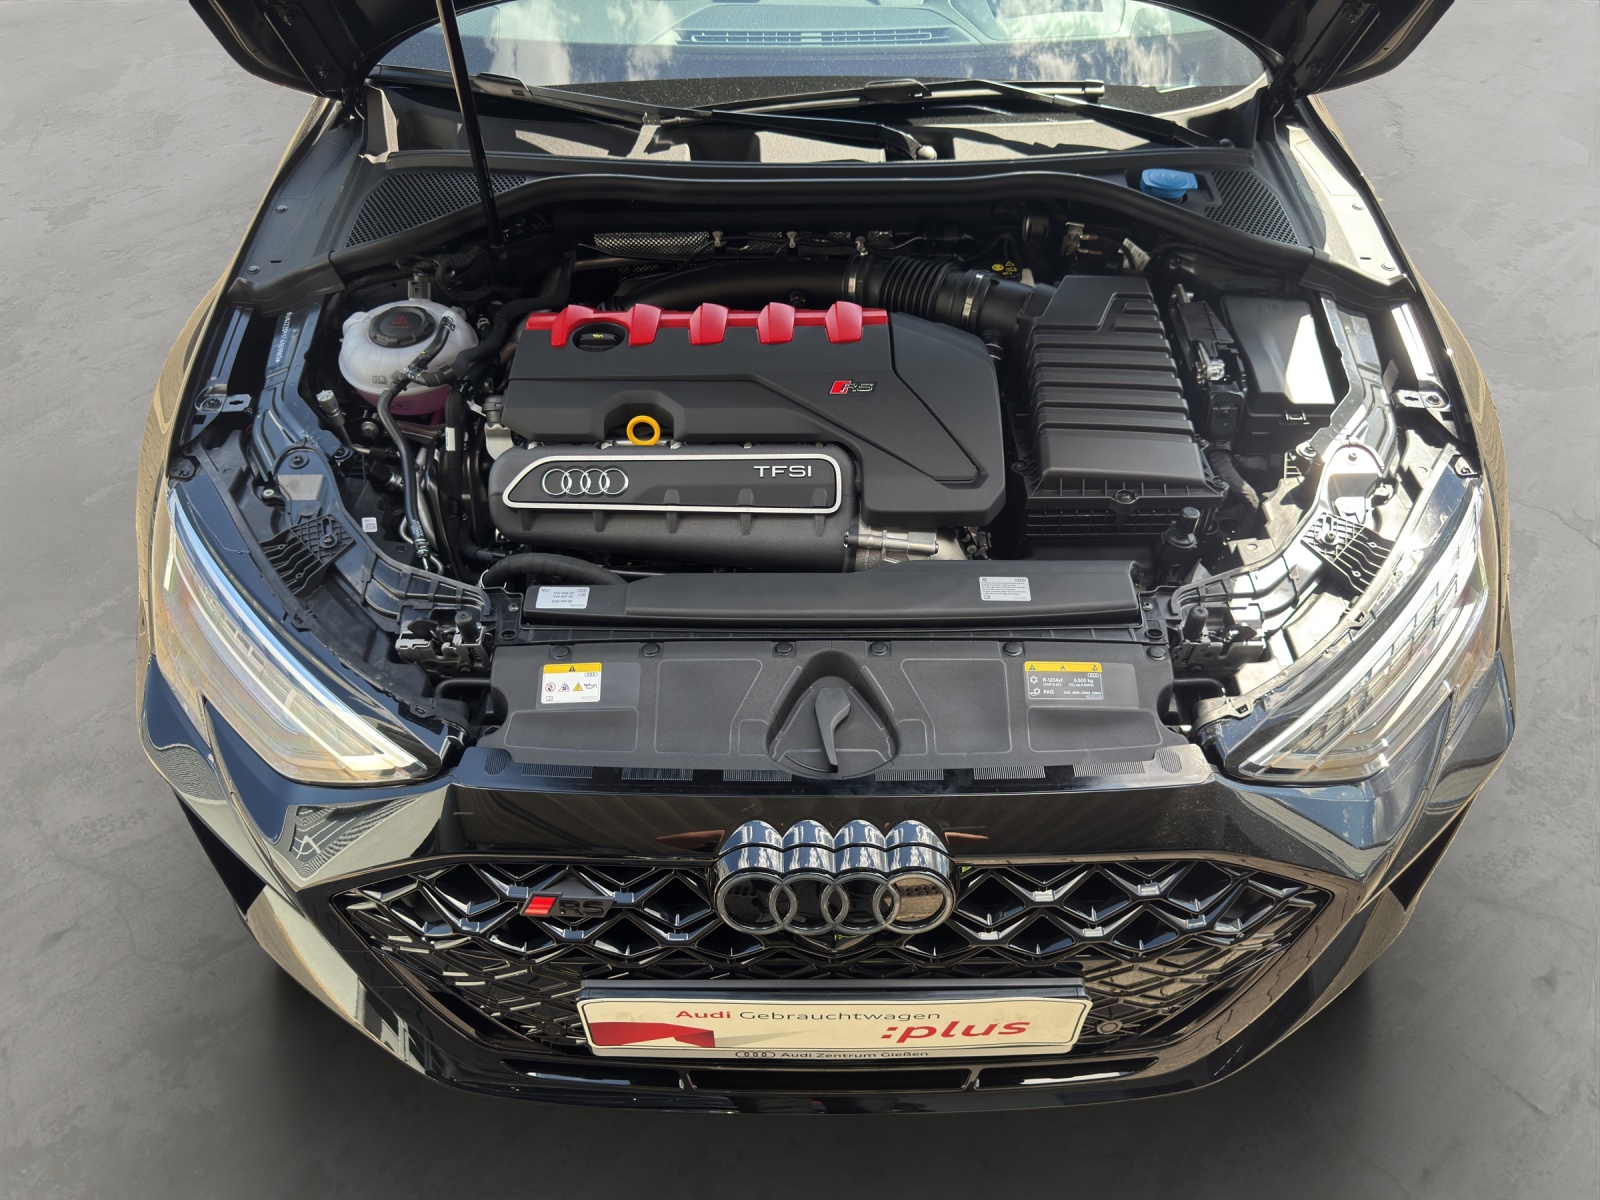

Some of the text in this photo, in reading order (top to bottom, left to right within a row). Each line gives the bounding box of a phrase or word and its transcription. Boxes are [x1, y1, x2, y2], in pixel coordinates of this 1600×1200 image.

[753, 465, 812, 478] TFSI
[559, 900, 604, 915] RS
[676, 1010, 940, 1022] Audi Gebrauchtwagen
